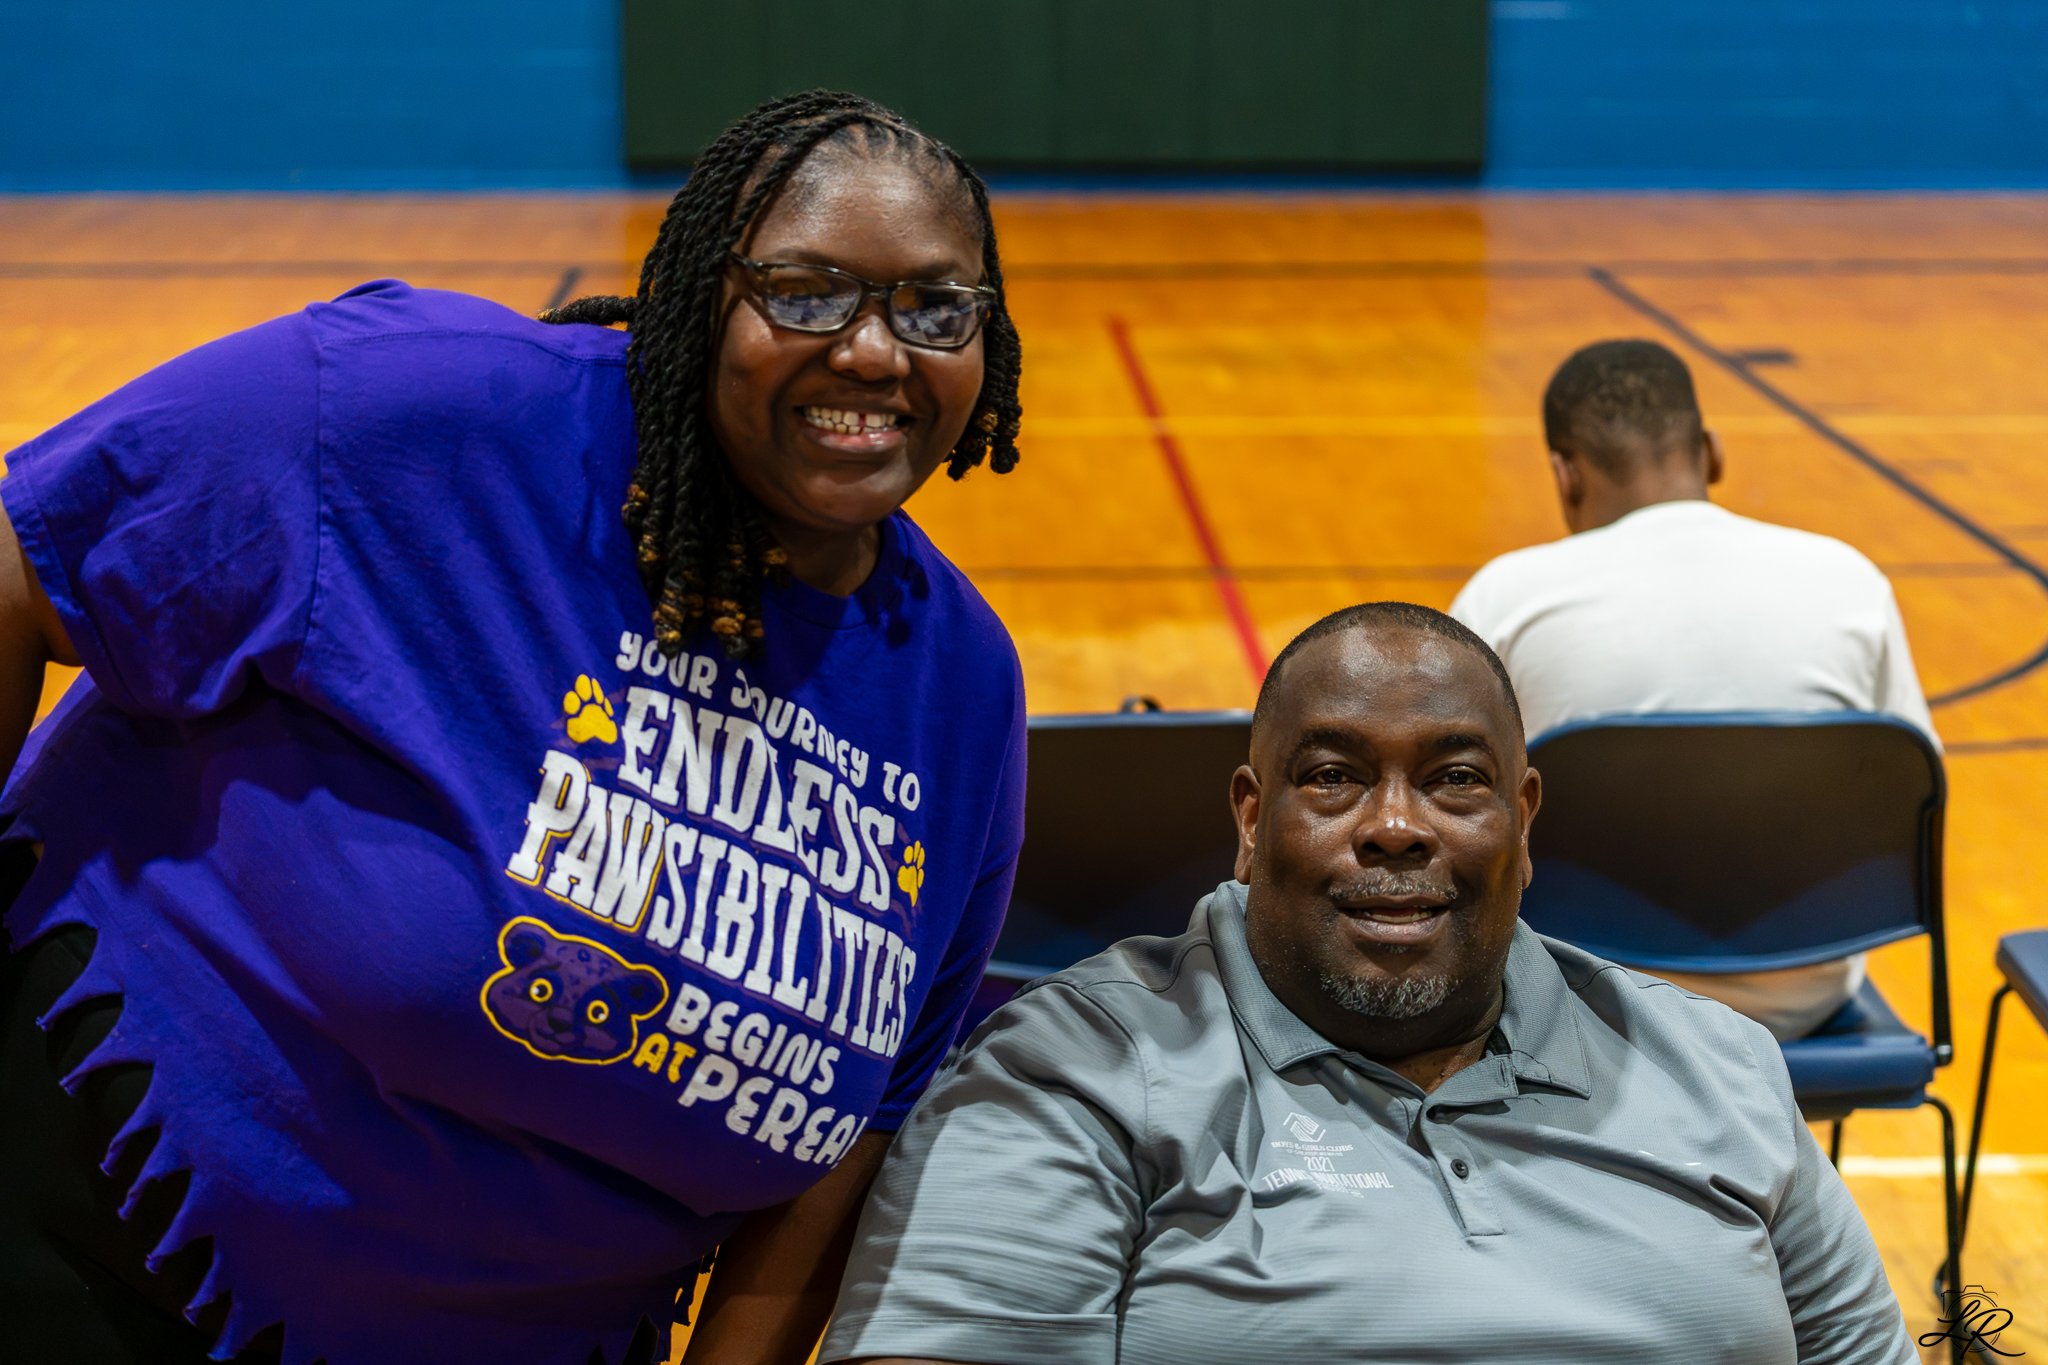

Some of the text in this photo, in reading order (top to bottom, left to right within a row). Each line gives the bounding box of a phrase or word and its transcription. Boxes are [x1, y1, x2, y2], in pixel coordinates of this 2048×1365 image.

[616, 631, 920, 811] YOUR JOURNEY TO
[617, 686, 896, 912] ENDLESS
[508, 749, 916, 1058] PAWSIBILITIES
[632, 1032, 697, 1083] AT
[666, 983, 841, 1095] BEGINS
[1304, 1156, 1336, 1172] 2021
